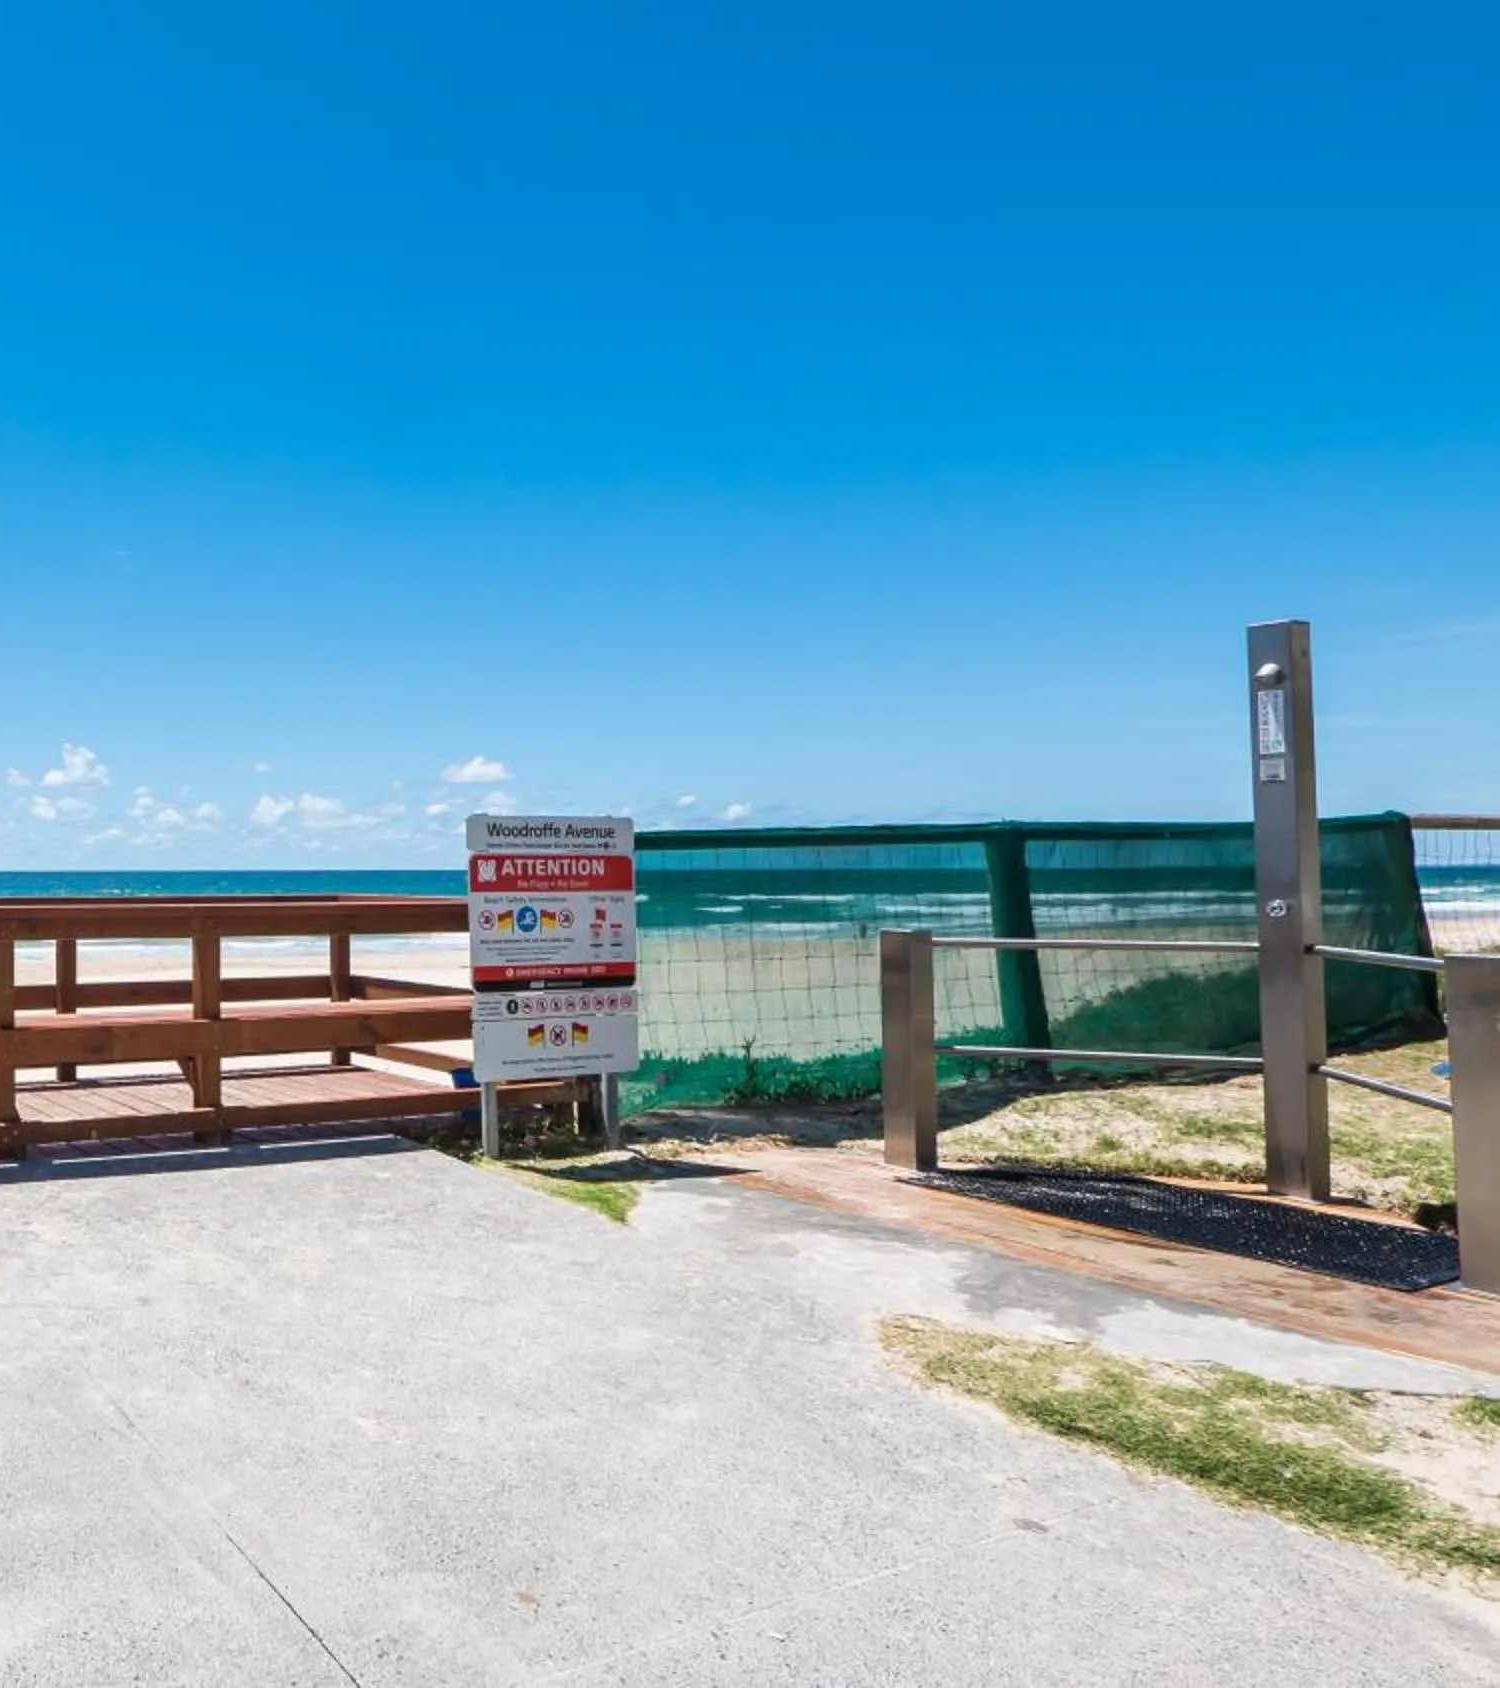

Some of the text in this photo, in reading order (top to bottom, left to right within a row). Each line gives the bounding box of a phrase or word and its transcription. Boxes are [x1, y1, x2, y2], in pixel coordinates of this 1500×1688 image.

[487, 822, 616, 839] Woodroffe Avenue
[501, 858, 606, 876] ATTENTION
